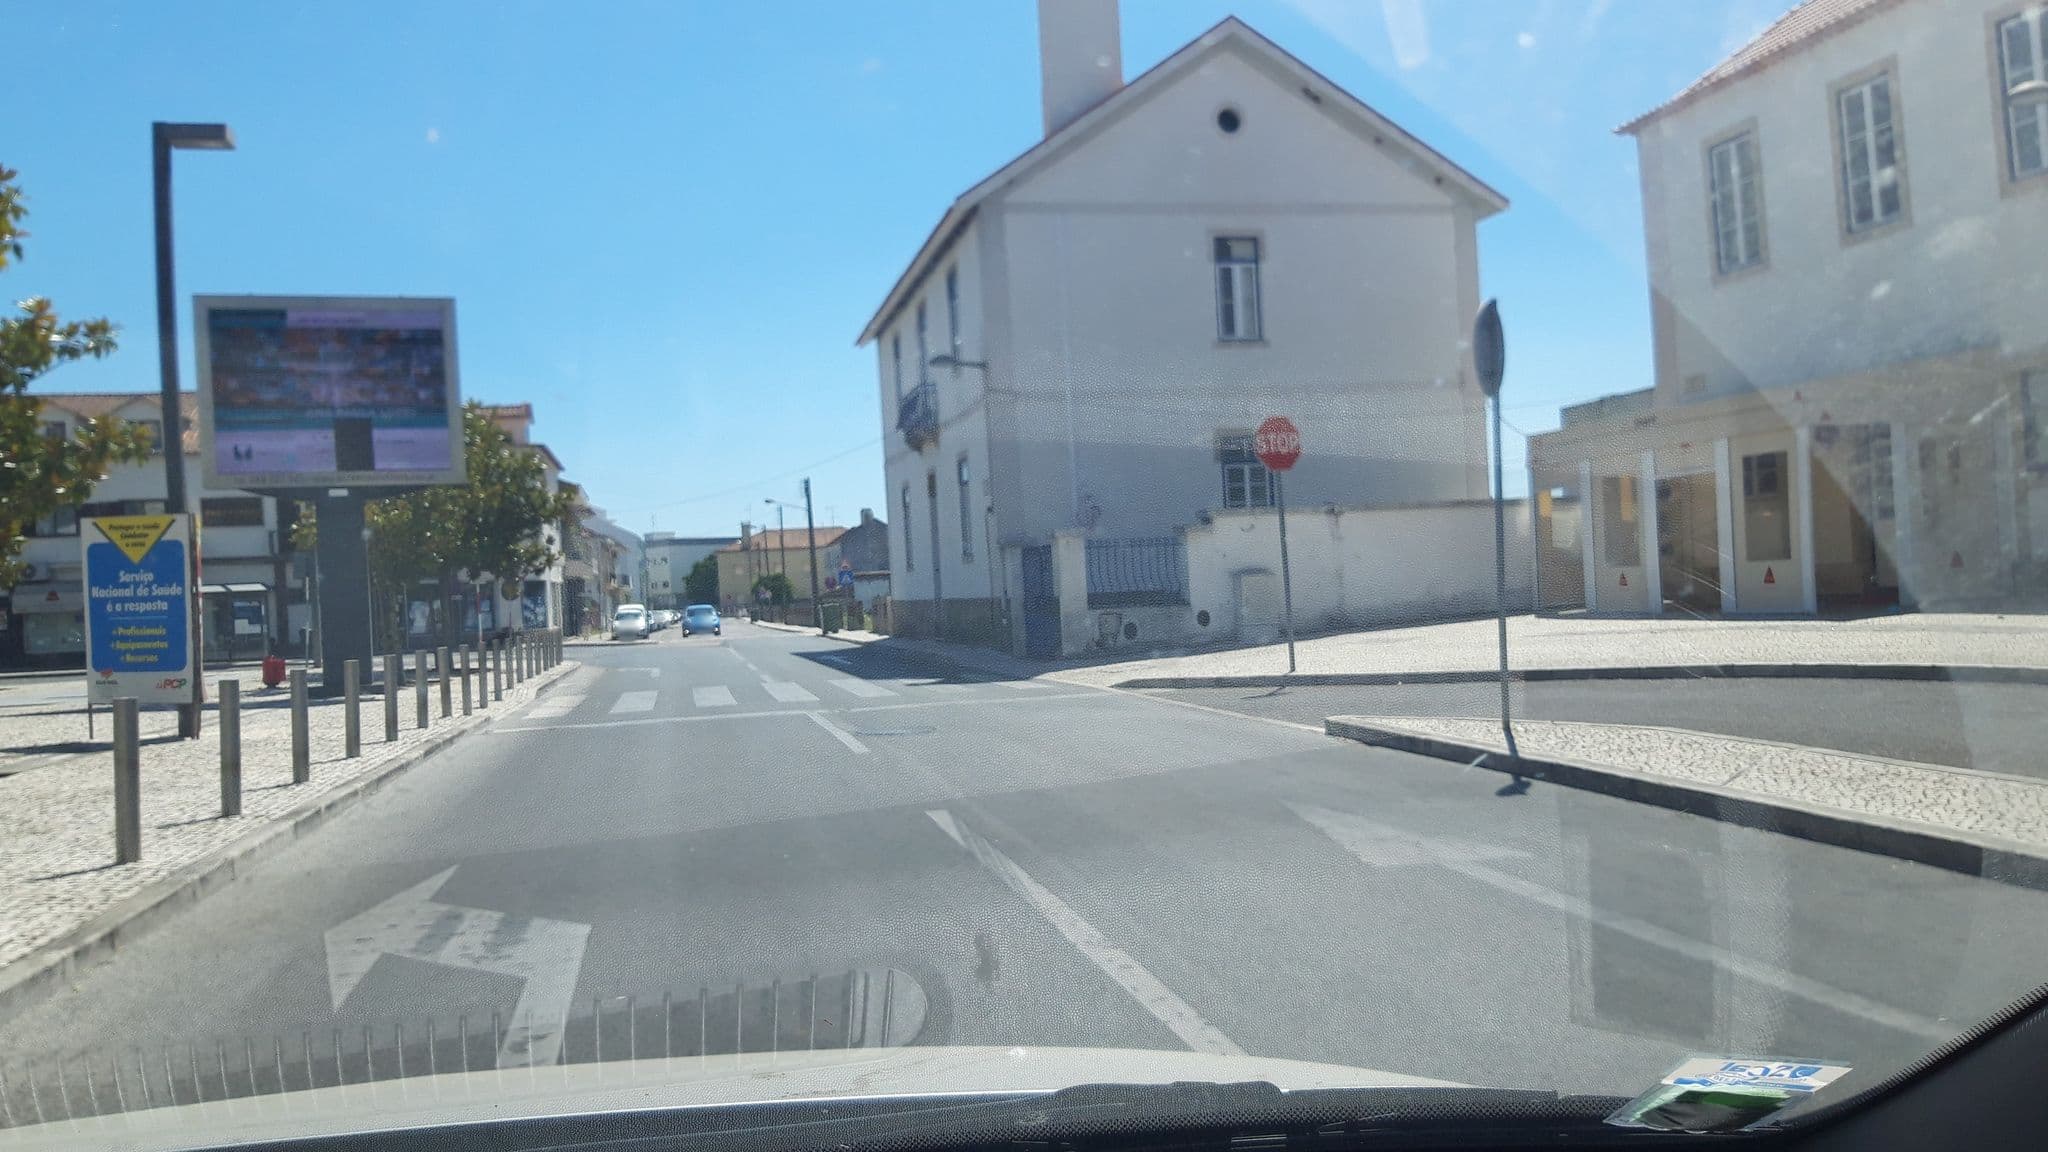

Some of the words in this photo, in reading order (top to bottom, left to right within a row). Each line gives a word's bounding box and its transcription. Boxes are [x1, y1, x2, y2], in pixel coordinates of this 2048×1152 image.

[1256, 433, 1300, 454] STOP
[119, 569, 154, 584] Serviço
[92, 584, 135, 598] Nacional
[137, 584, 149, 596] de
[151, 582, 183, 596] Saúde
[106, 600, 113, 612] é
[124, 600, 168, 613] resposta
[164, 679, 187, 689] PCP
